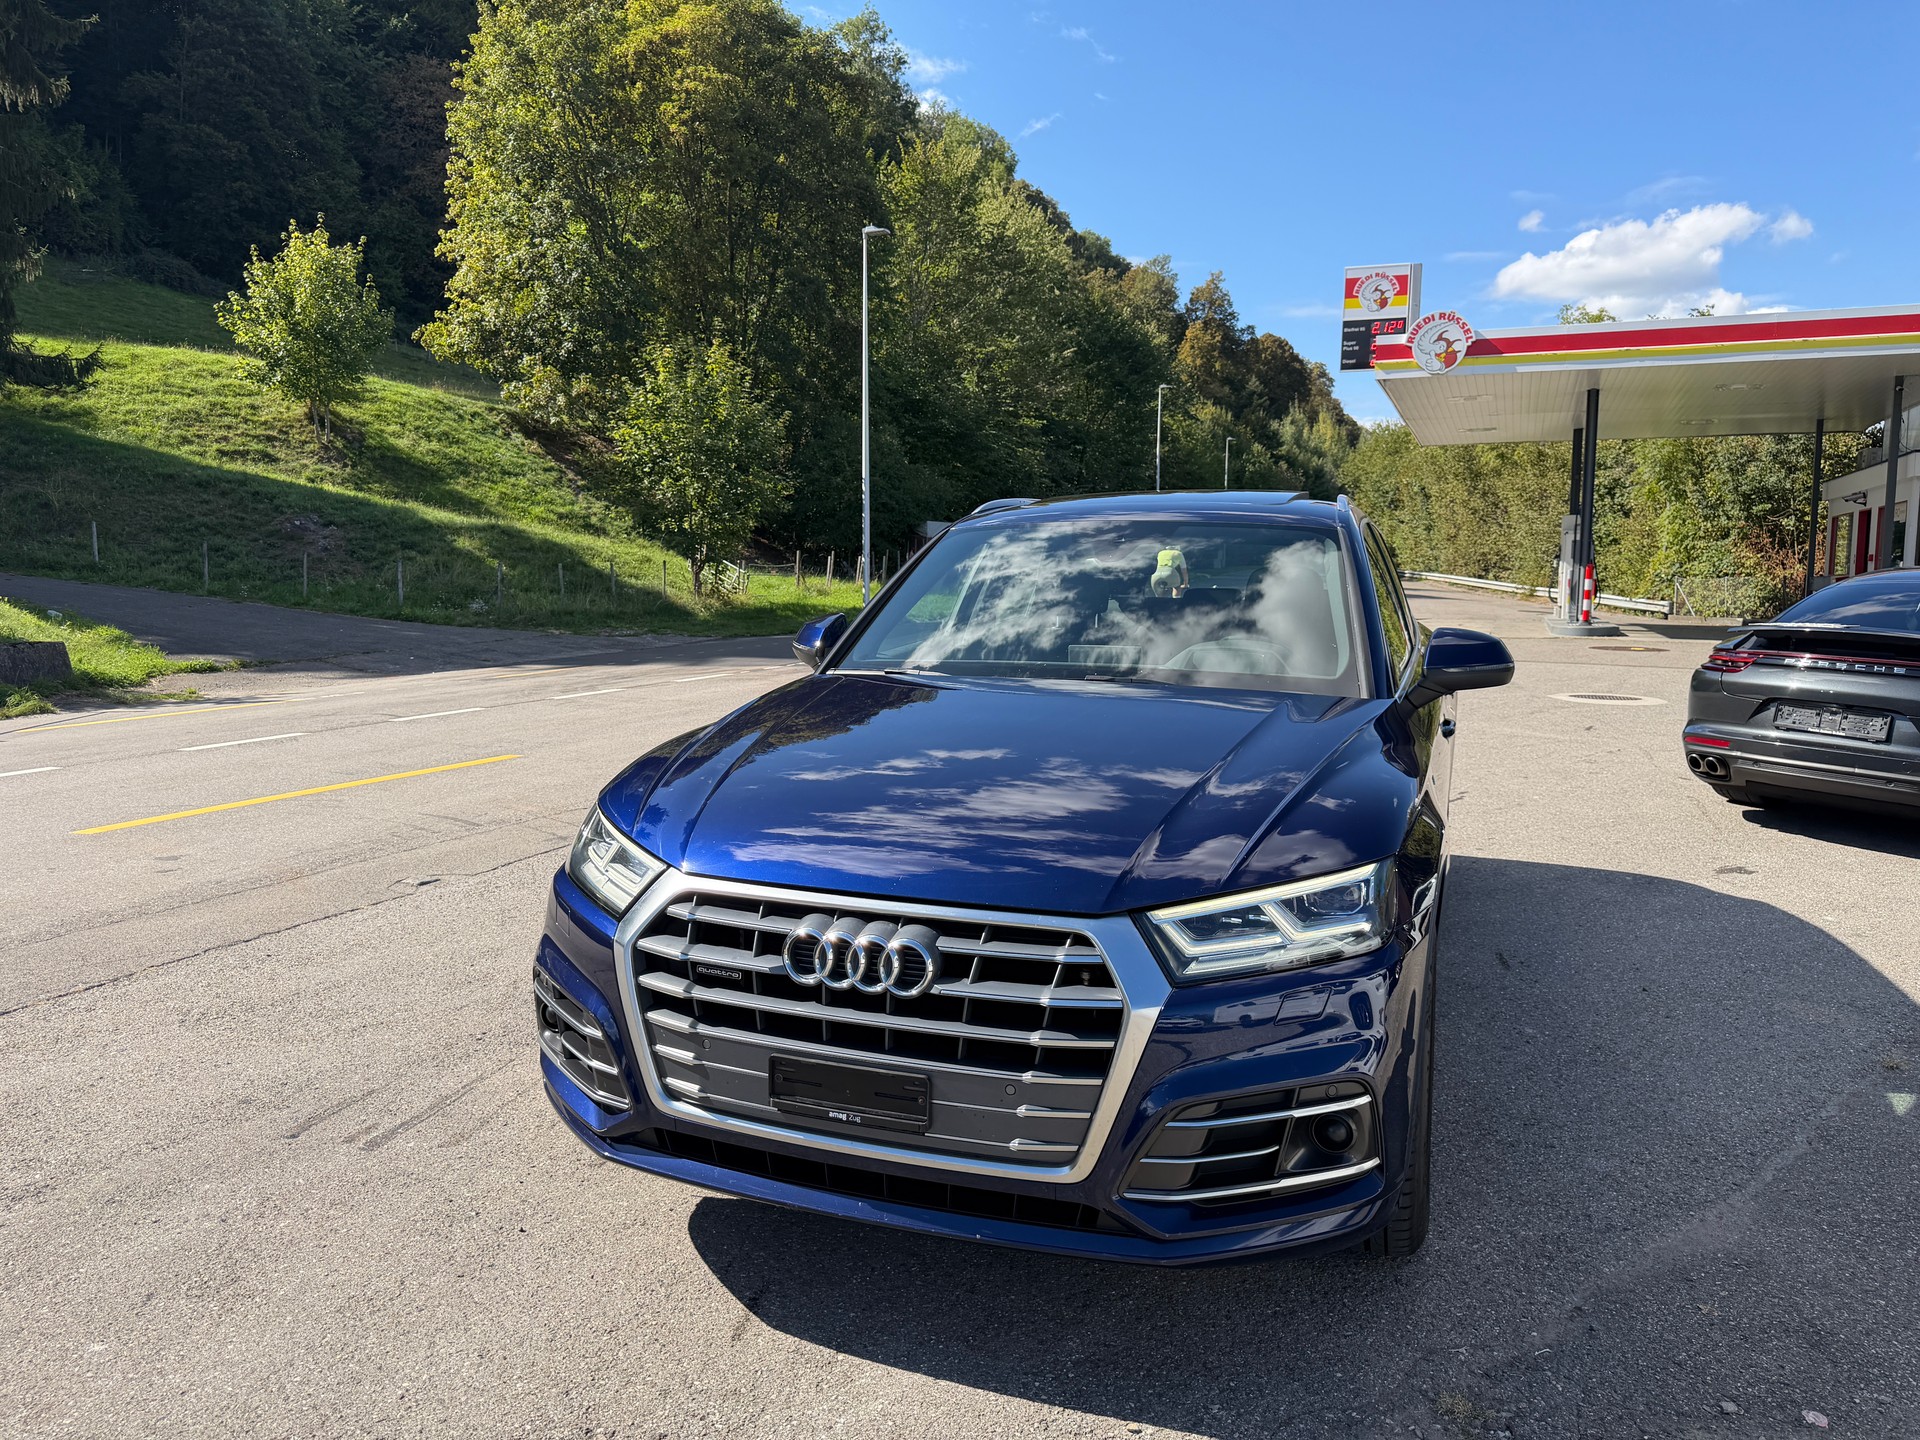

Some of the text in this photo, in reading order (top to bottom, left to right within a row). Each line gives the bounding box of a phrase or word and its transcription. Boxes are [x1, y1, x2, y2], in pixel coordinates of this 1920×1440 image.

[1354, 271, 1399, 295] RUEDI RÜSSEL
[1407, 310, 1475, 345] RUEDI RÜSSEL
[1784, 657, 1906, 674] PORSCHE
[698, 966, 739, 978] quattro
[828, 1111, 861, 1123] amag Zug
